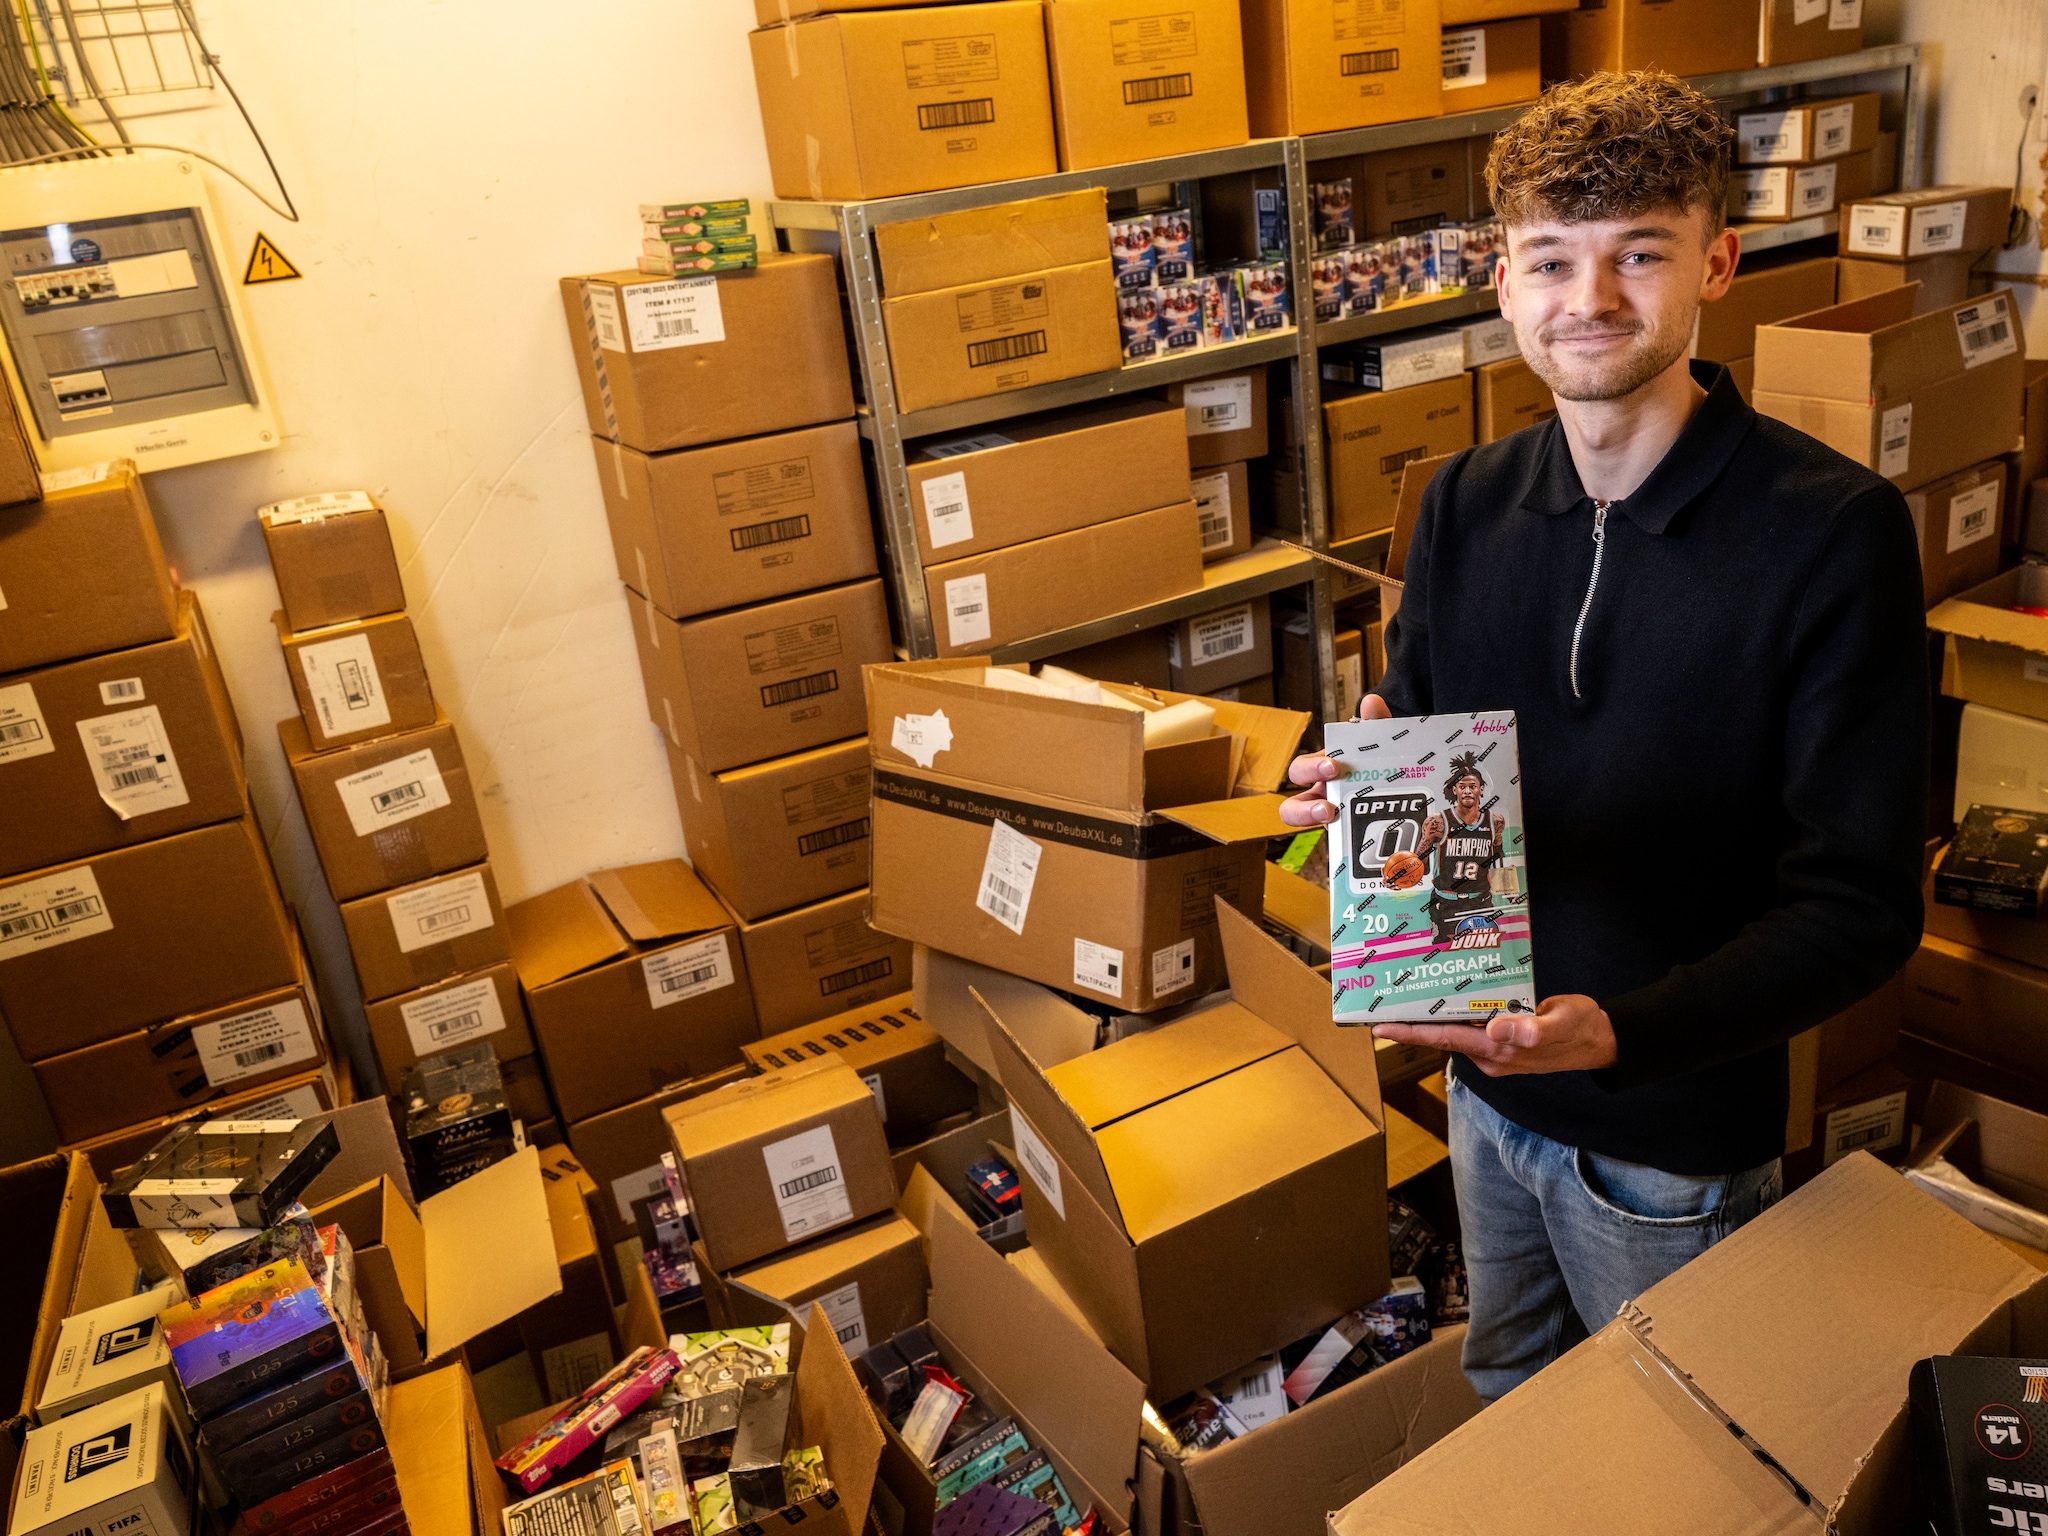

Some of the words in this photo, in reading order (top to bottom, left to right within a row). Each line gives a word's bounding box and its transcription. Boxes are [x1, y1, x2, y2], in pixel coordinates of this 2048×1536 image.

[667, 279, 715, 291] ENTERTAINMENT
[645, 300, 664, 308] ITEM
[1472, 719, 1509, 736] Hobby
[1399, 765, 1436, 774] TRADING
[1354, 799, 1424, 815] OPTIC
[947, 799, 1027, 826] www.DeubaXXL.de
[1032, 818, 1123, 847] www.DeubaXXL.de
[1446, 838, 1492, 857] MEMPHIS
[1453, 860, 1479, 881] 12
[1342, 904, 1357, 923] 4
[1472, 919, 1484, 928] NBA
[1362, 914, 1389, 934] 20
[1450, 931, 1500, 950] DUNK
[1076, 973, 1113, 990] MULTIPACK
[1337, 974, 1375, 991] FIND
[1384, 970, 1391, 984] 1
[1396, 953, 1501, 982] AUTOGRAPH
[1155, 976, 1186, 993] MULTIPACK
[1373, 986, 1393, 997] AND
[1394, 985, 1404, 993] 20
[1406, 980, 1440, 992] INSERTS
[1441, 977, 1454, 985] OR
[1456, 973, 1483, 983] PRIZM
[61, 1349, 72, 1373] PANINI
[250, 1357, 282, 1380] 125
[649, 1360, 670, 1379] SEASON
[267, 1396, 299, 1418] 125
[1981, 1415, 2020, 1425] Holders
[283, 1424, 315, 1447] 125
[1985, 1424, 2022, 1445] 14
[67, 1445, 82, 1480] DONRUSS
[294, 1451, 326, 1472] 125
[931, 1459, 963, 1482] CARDS
[29, 1464, 40, 1494] PANINI
[107, 1513, 141, 1533] FIFA
[312, 1509, 341, 1531] 125
